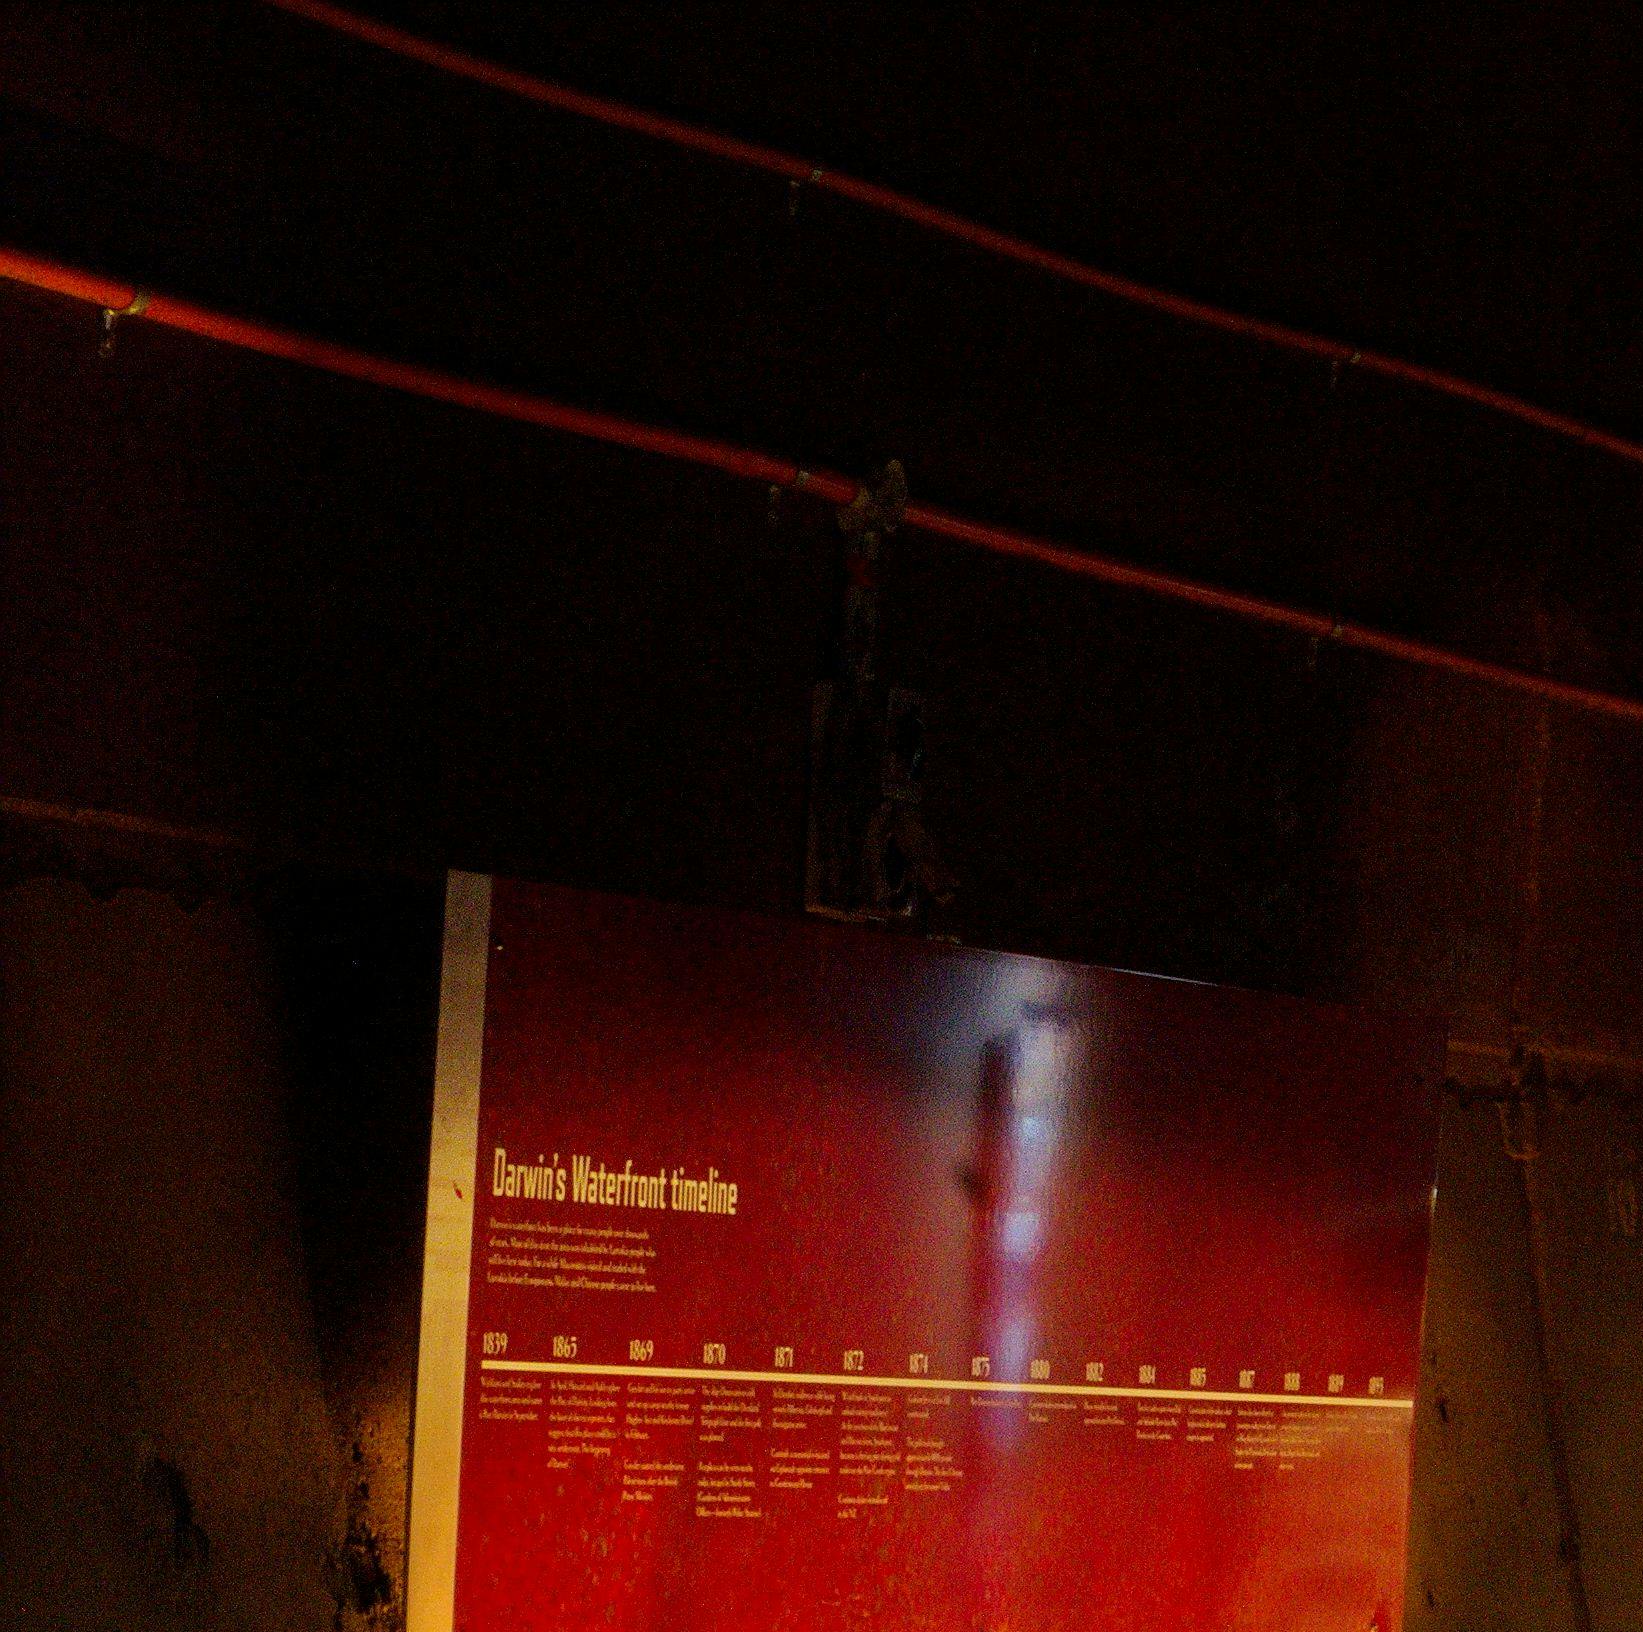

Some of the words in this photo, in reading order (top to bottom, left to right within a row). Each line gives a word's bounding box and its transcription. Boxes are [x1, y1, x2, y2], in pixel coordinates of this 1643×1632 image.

[493, 1147, 567, 1202] Darwin's
[572, 1153, 667, 1210] Waterfront
[671, 1165, 738, 1216] timeline
[482, 1331, 508, 1355] 1839
[629, 1339, 655, 1361] 1869
[703, 1343, 727, 1365] 1870
